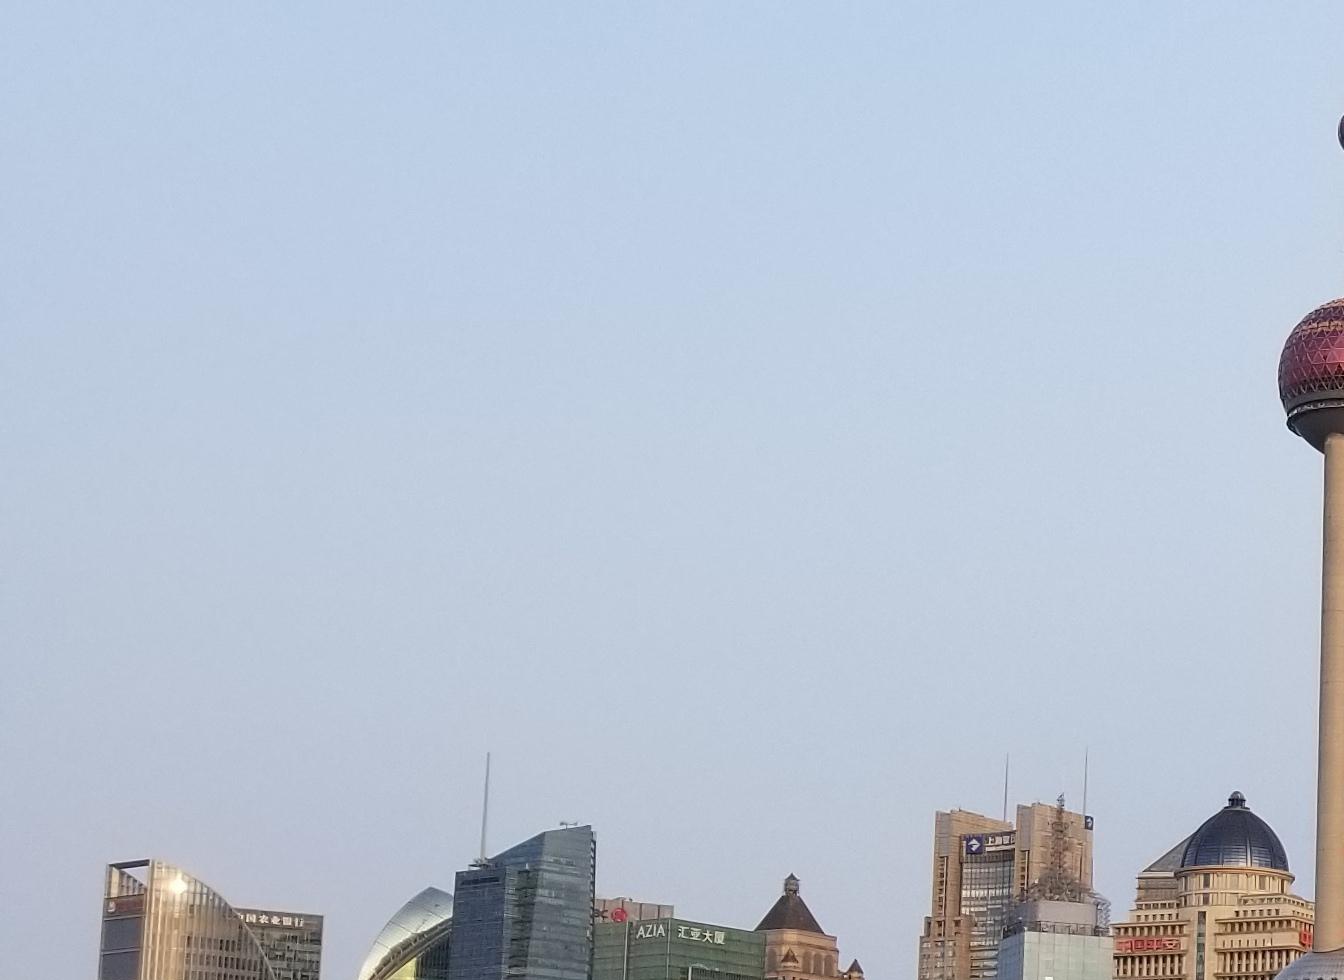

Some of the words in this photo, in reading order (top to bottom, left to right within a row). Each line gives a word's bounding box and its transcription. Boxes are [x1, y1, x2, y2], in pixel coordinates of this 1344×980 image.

[636, 924, 666, 939] AZIA
[677, 926, 726, 945] 汇亚大厦
